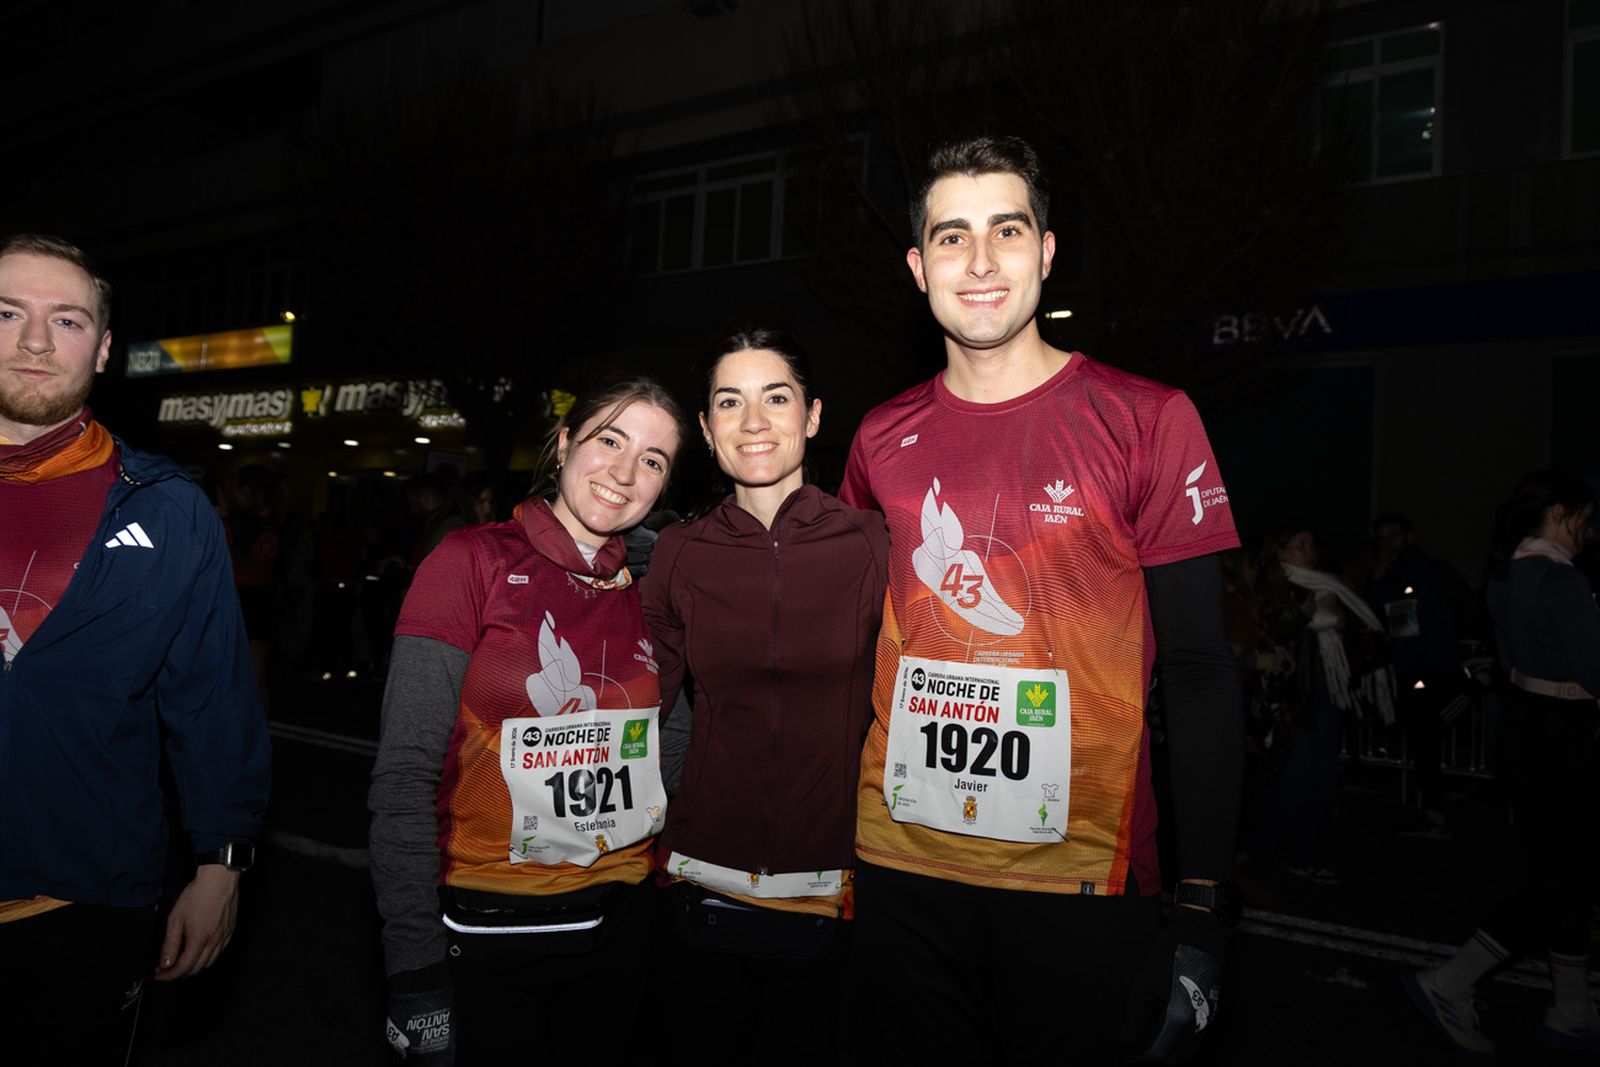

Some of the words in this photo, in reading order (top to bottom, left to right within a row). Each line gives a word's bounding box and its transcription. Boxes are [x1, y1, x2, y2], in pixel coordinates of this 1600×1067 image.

[157, 388, 287, 428] masymas
[1029, 503, 1051, 512] CAJA
[1053, 505, 1084, 517] RURAL
[1203, 499, 1211, 508] DE
[1044, 513, 1067, 525] JAÉN
[940, 563, 984, 609] 43
[912, 672, 925, 685] 43
[965, 676, 1000, 685] INTERNACIONAL
[927, 679, 976, 699] NOCHE
[979, 685, 1000, 701] DE
[908, 696, 938, 717] SAN
[940, 700, 1000, 724] ANTÓN
[523, 731, 541, 742] 43
[544, 729, 595, 747] NOCHE
[596, 727, 611, 742] DE
[522, 751, 557, 770] SAN
[561, 743, 610, 767] ANTÓN
[920, 721, 1031, 781] 1920
[544, 764, 633, 818] 1921
[954, 778, 988, 792] Javier
[406, 1011, 451, 1033] ANTÓN
[422, 1024, 450, 1041] SAN
